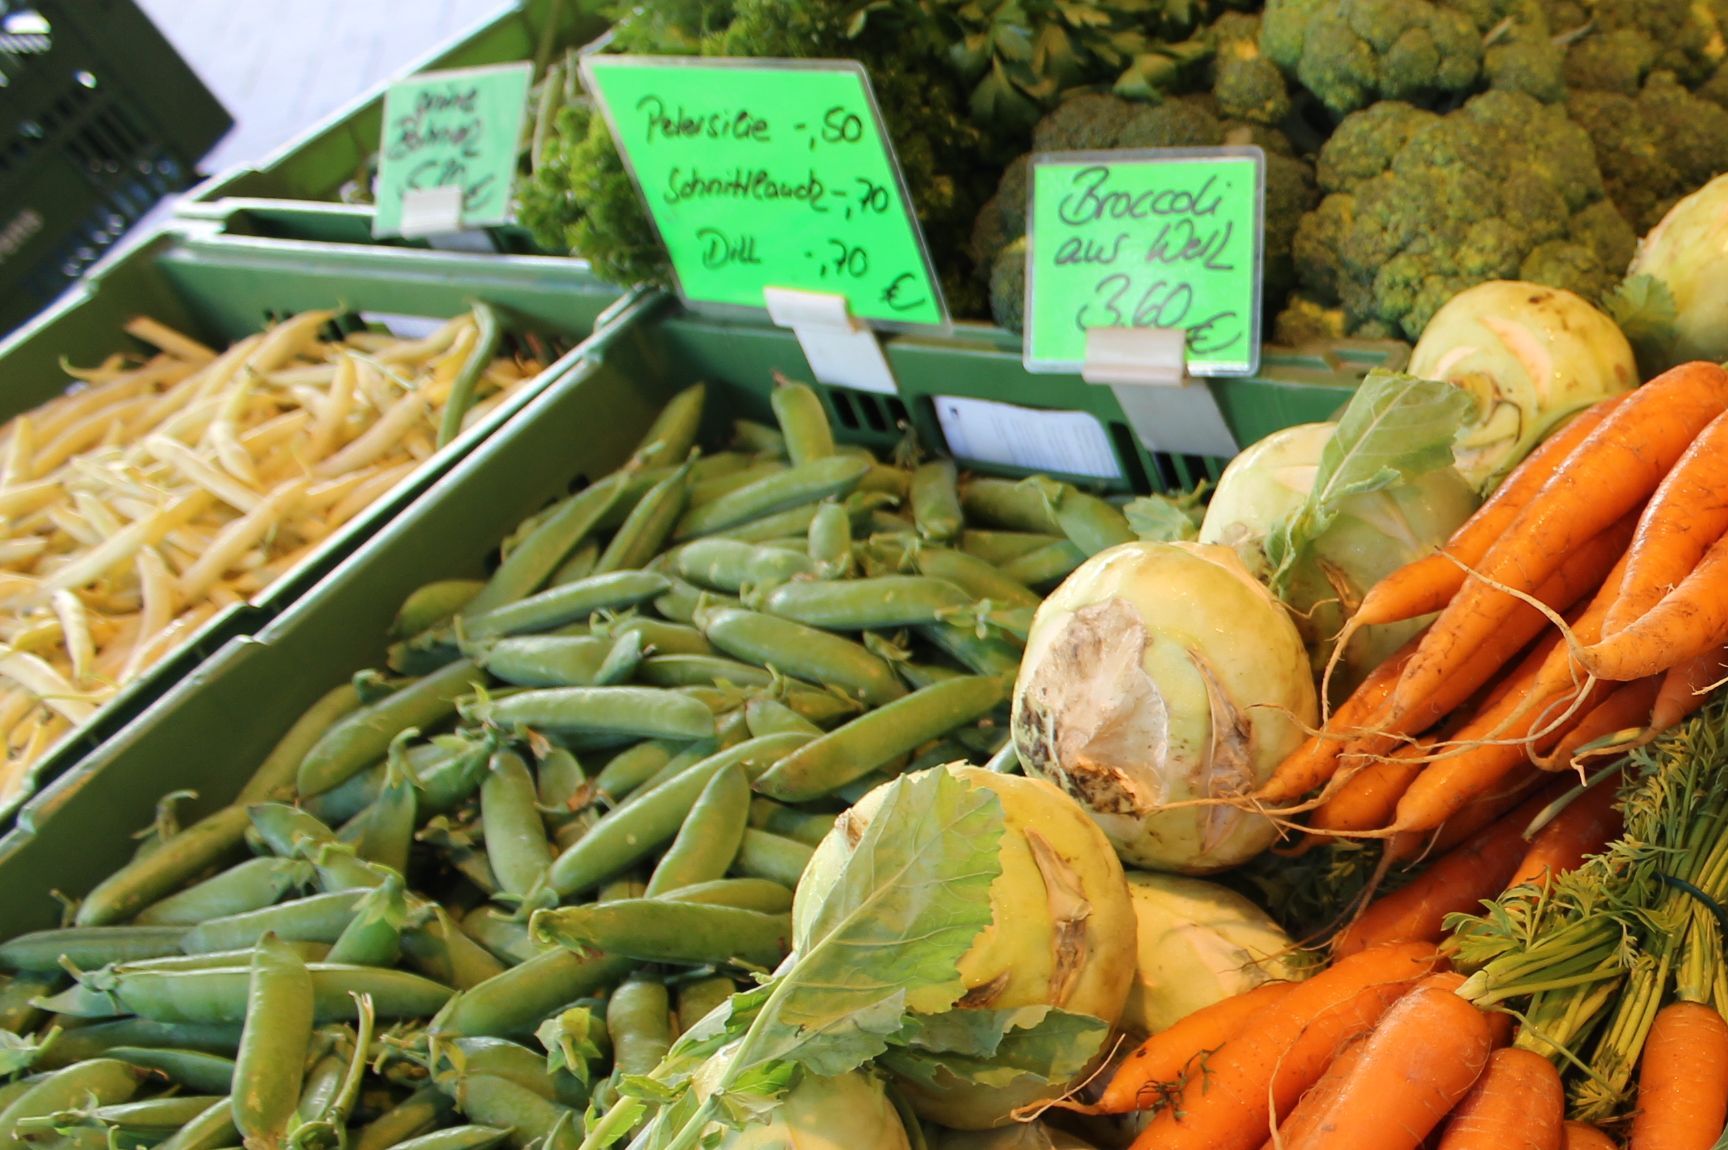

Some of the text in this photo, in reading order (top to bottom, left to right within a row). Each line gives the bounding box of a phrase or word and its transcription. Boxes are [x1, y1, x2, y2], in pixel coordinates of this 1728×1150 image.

[636, 94, 770, 143] Petersilie
[664, 168, 828, 212] Schnittlauch
[1059, 165, 1233, 225] Broccoli
[696, 227, 761, 270] Dill
[1055, 233, 1129, 266] aus
[880, 271, 925, 311] €
[1186, 311, 1242, 355] €
